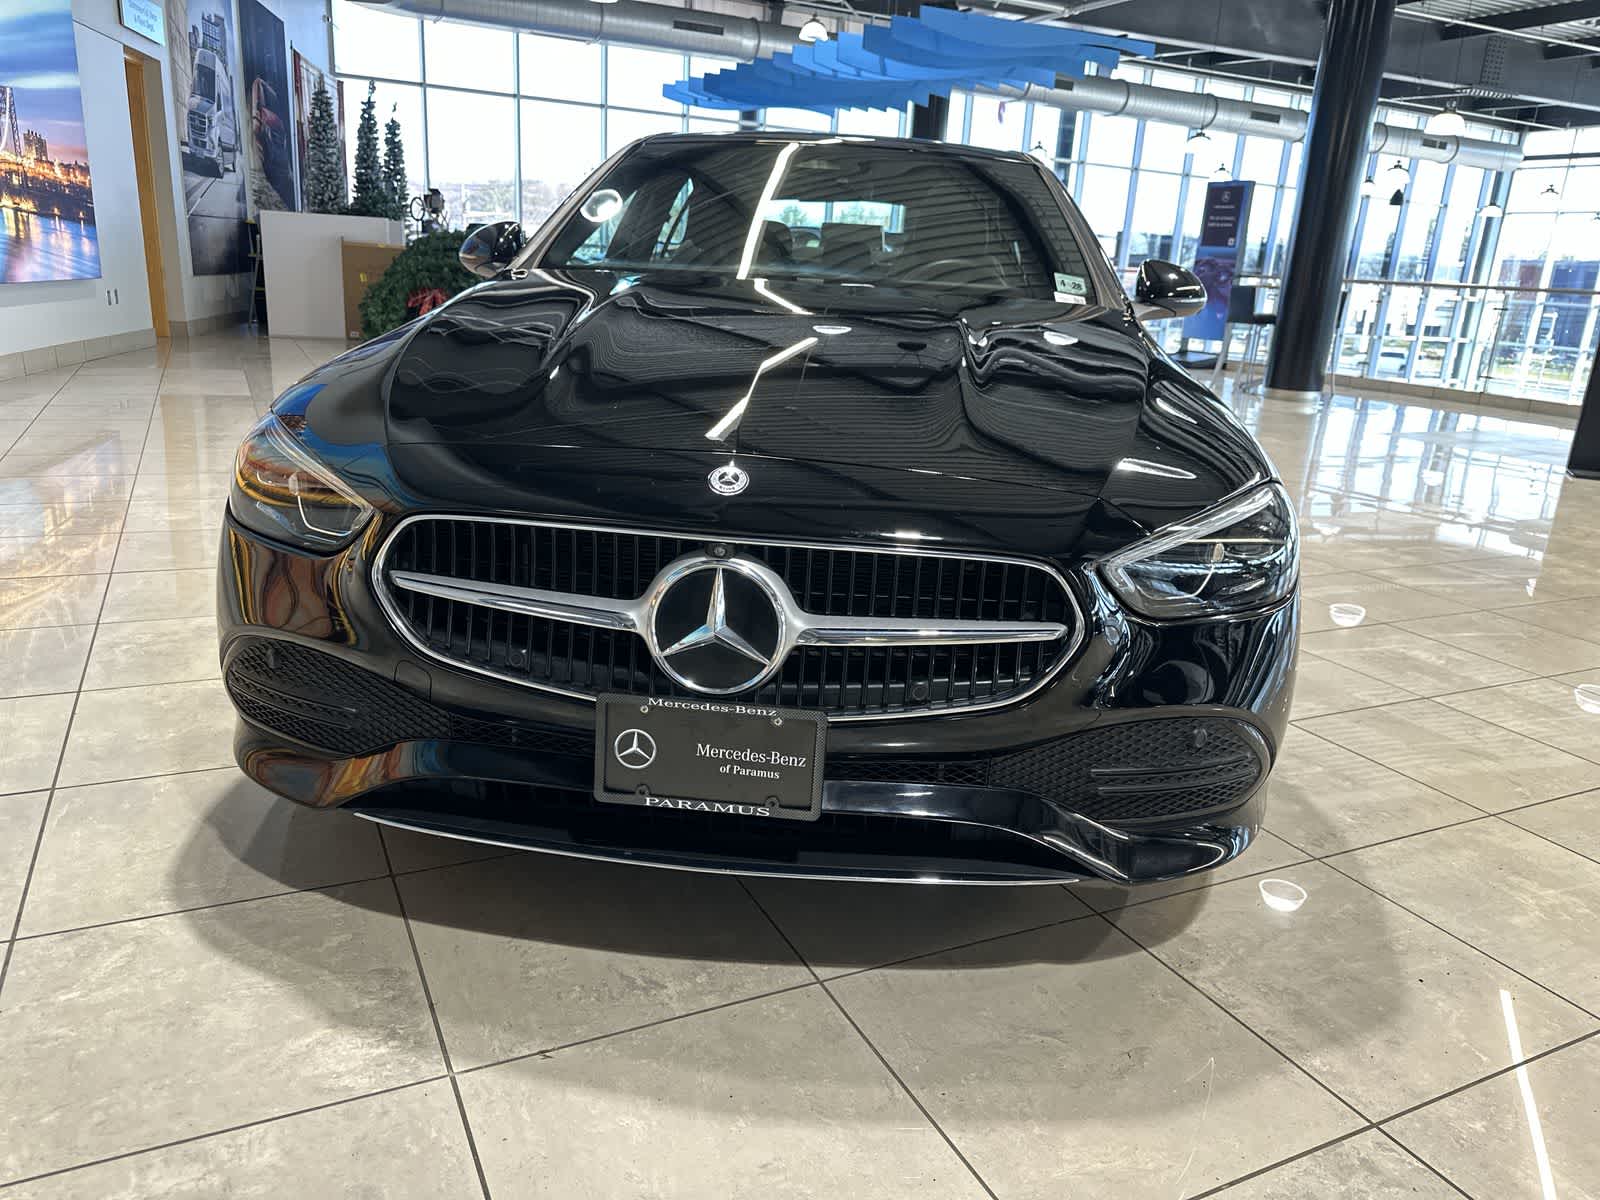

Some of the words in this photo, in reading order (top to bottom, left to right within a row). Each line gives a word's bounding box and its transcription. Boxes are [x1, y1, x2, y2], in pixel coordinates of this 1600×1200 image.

[648, 697, 778, 717] Mercedes-Benz
[696, 743, 807, 768] Mercedes-Benz
[719, 764, 731, 775] of
[733, 765, 780, 780] Paramus
[645, 797, 770, 817] PARAMUS
